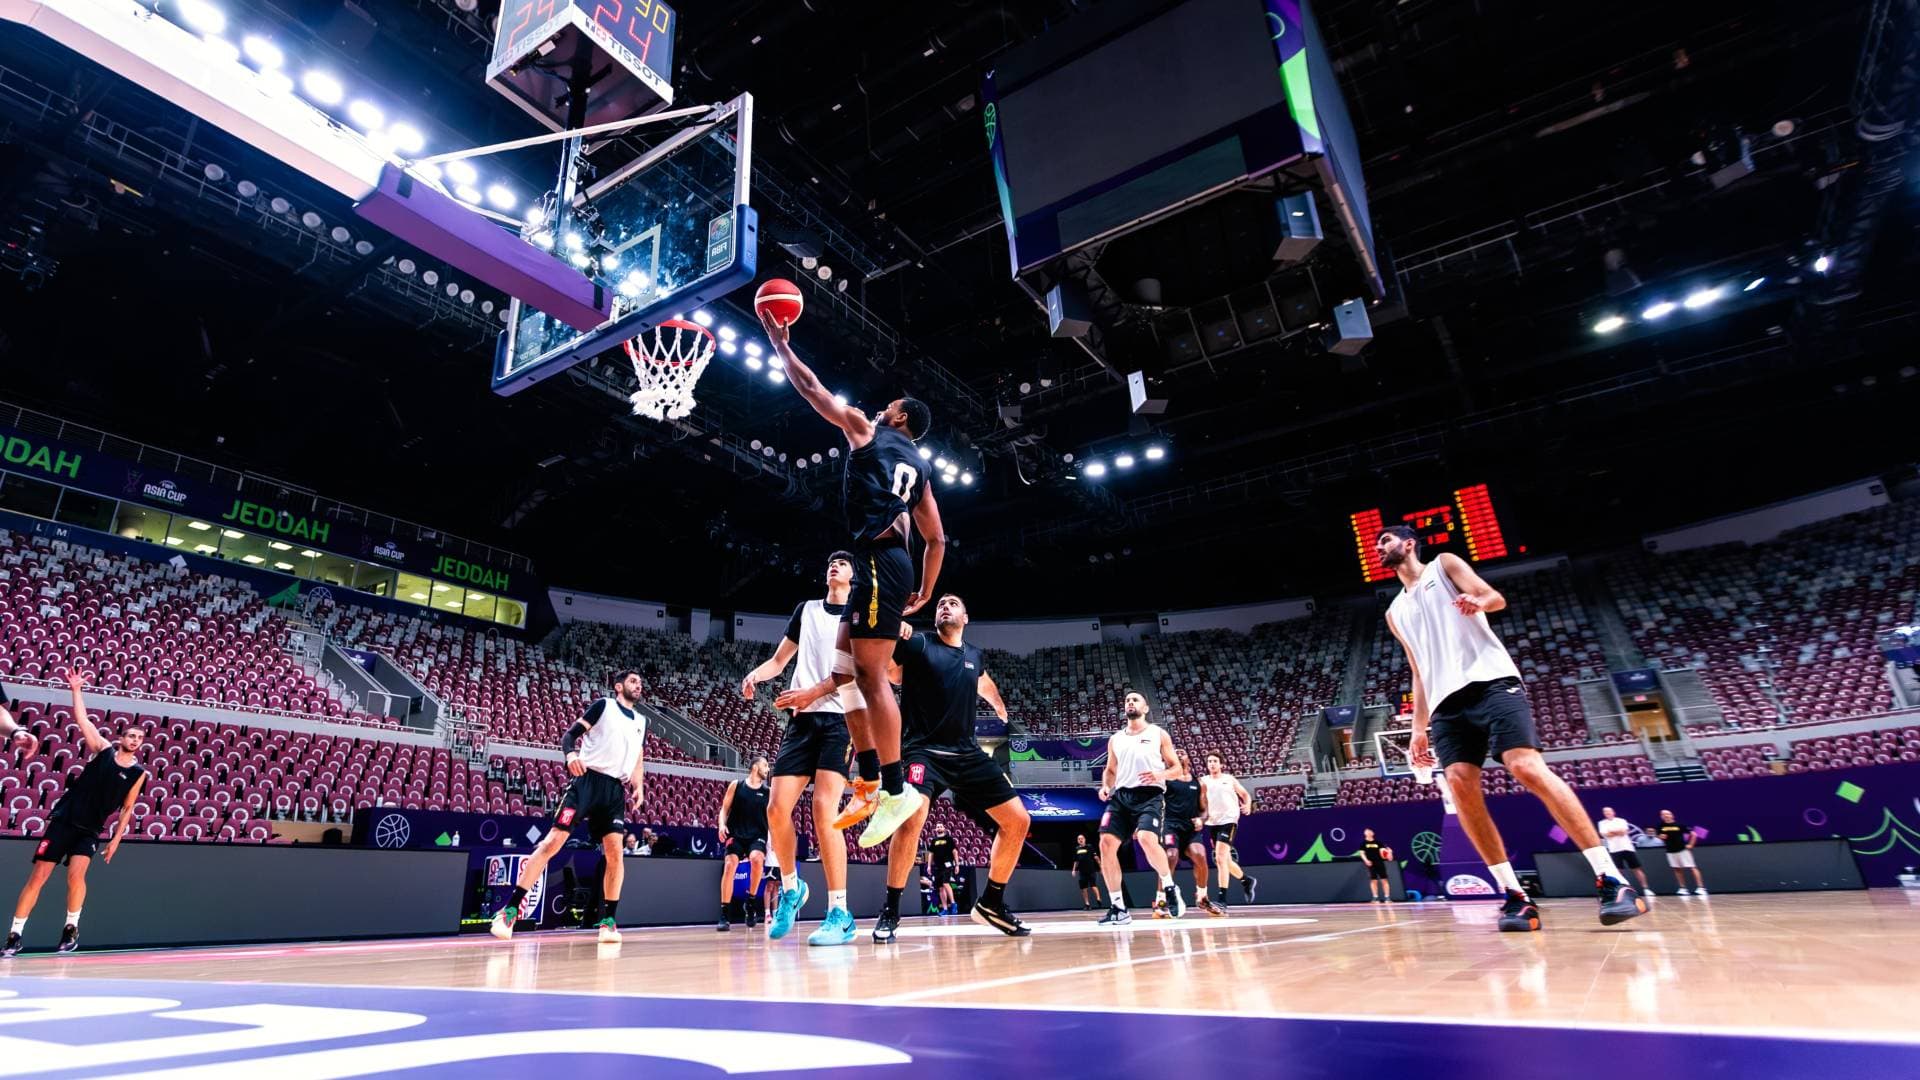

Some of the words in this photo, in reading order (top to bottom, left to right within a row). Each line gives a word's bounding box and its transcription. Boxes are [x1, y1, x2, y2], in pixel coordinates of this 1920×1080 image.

[608, 36, 662, 87] TISSOT
[0, 434, 82, 478] DAH
[143, 483, 168, 498] ASIA
[167, 490, 187, 503] CUP
[56, 527, 67, 537] M
[222, 499, 331, 544] JEDDAH
[373, 545, 391, 558] ASIA
[390, 550, 405, 561] CUP
[431, 555, 509, 592] JEDDAH
